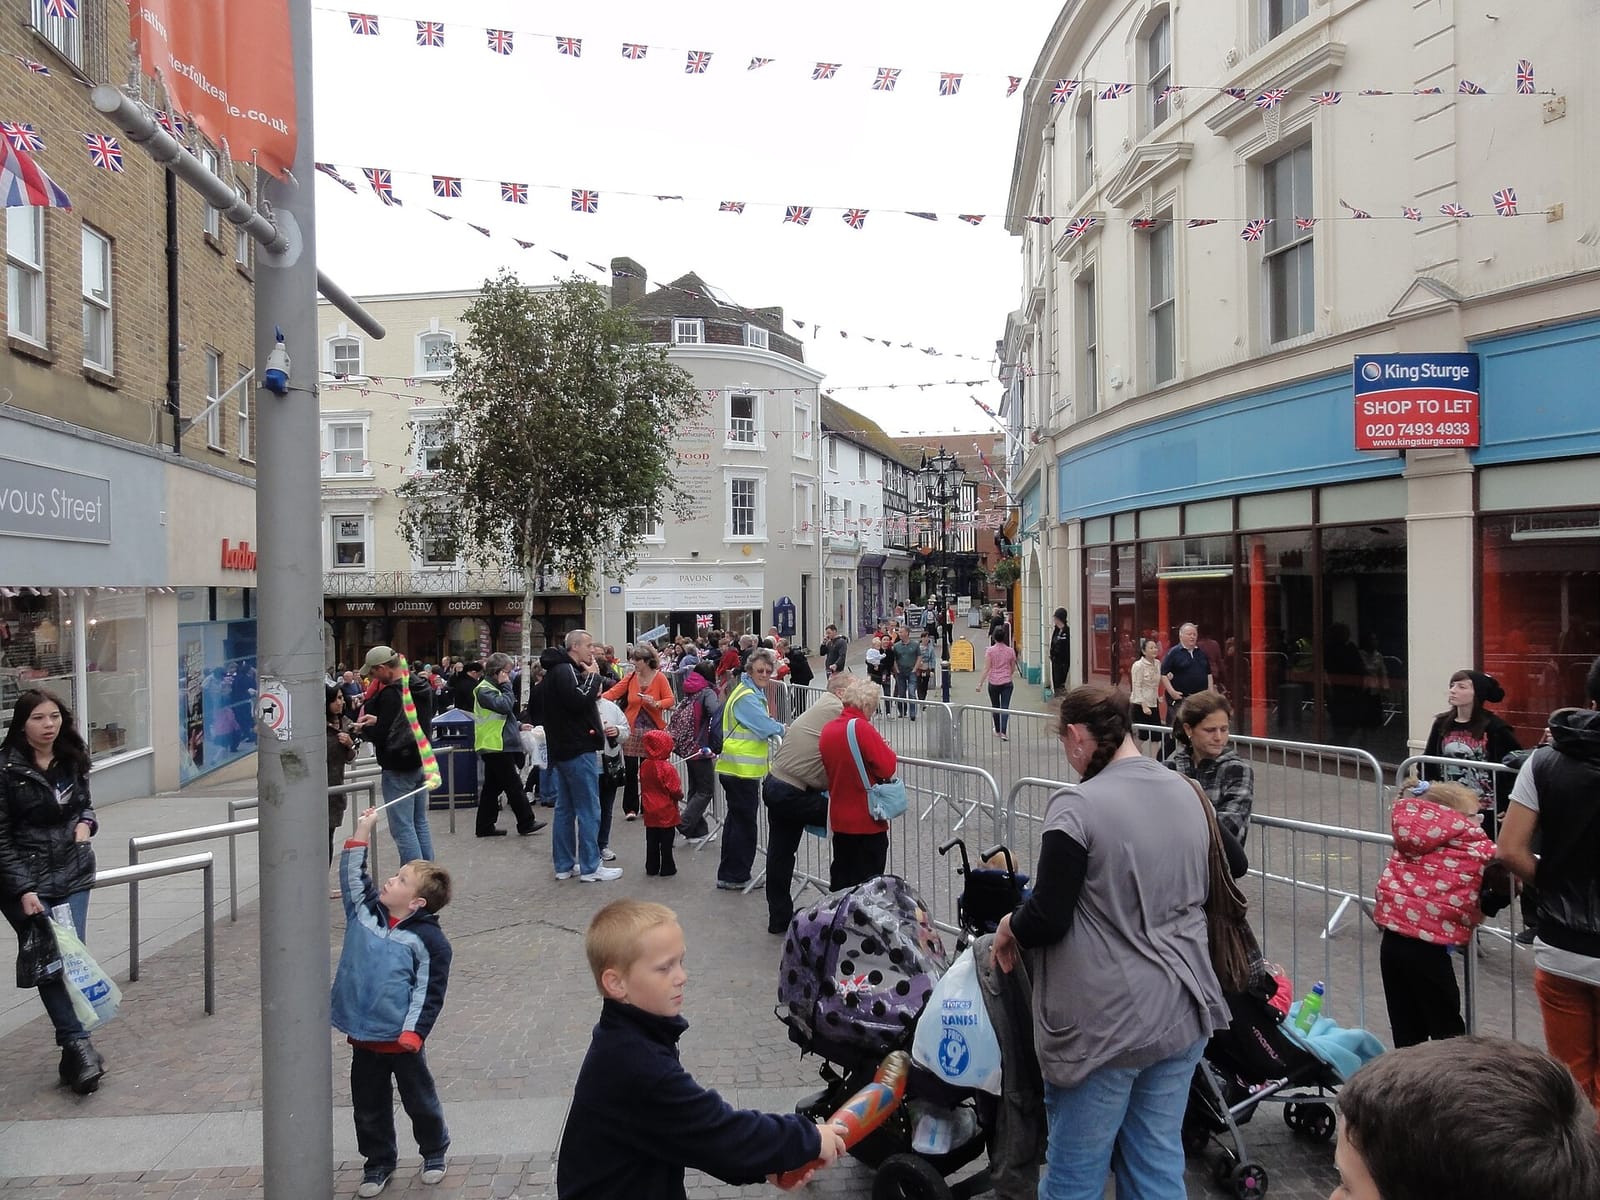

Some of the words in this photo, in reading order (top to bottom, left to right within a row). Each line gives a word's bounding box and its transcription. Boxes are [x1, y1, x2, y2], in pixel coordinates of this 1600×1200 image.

[1421, 363, 1469, 381] Sturge
[1363, 401, 1412, 415] SHOP
[1416, 400, 1440, 414] TO
[1444, 400, 1472, 413] LET
[1366, 424, 1394, 437] 020
[1397, 423, 1433, 436] 7493
[1436, 422, 1470, 435] 4933
[1372, 437, 1464, 447] www.kingsturge.com
[50, 487, 102, 524] Street
[679, 574, 713, 583] PAVONE
[393, 601, 433, 613] johnny
[448, 601, 483, 611] cotter
